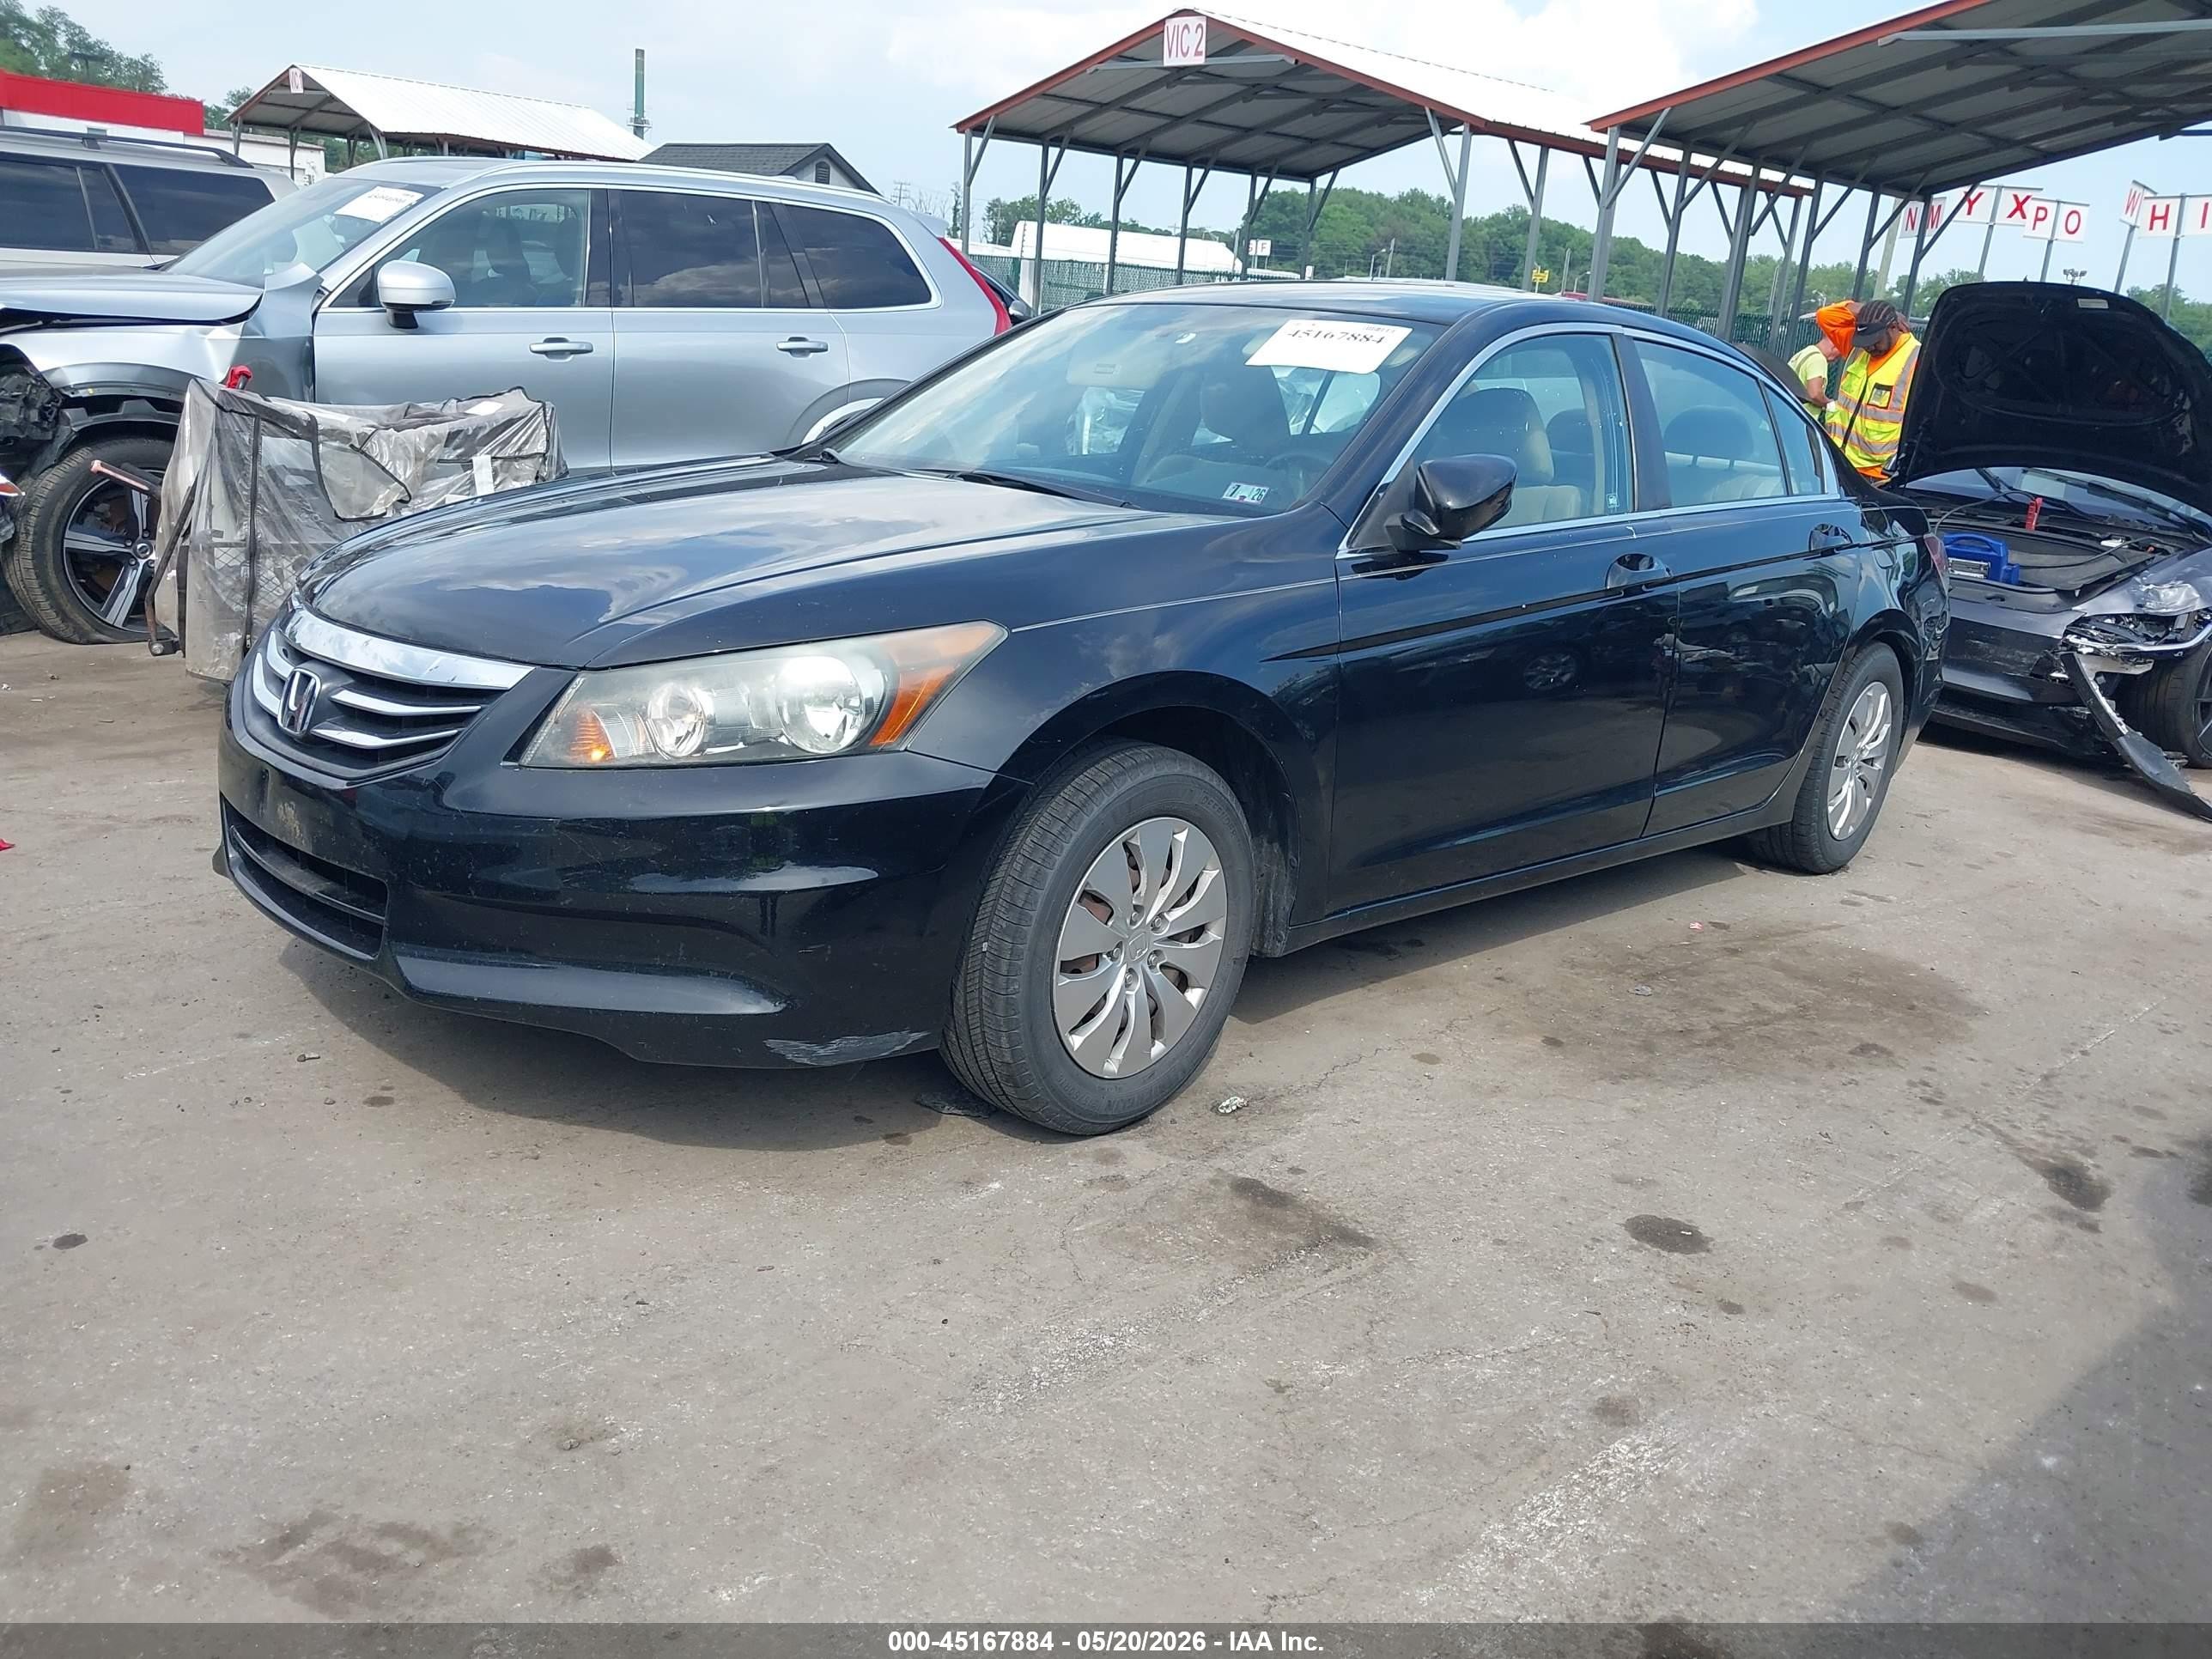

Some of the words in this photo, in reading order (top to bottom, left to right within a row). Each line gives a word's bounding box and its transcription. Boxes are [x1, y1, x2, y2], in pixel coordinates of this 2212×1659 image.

[1166, 23, 1190, 59] VIC
[1194, 22, 1204, 57] 2
[1905, 207, 1918, 232] N
[2006, 194, 2033, 220] X
[2148, 204, 2171, 232] H
[2032, 206, 2048, 231] P
[2064, 210, 2081, 235] O
[1287, 328, 1386, 345] 45167884
[1250, 488, 1267, 501] 26
